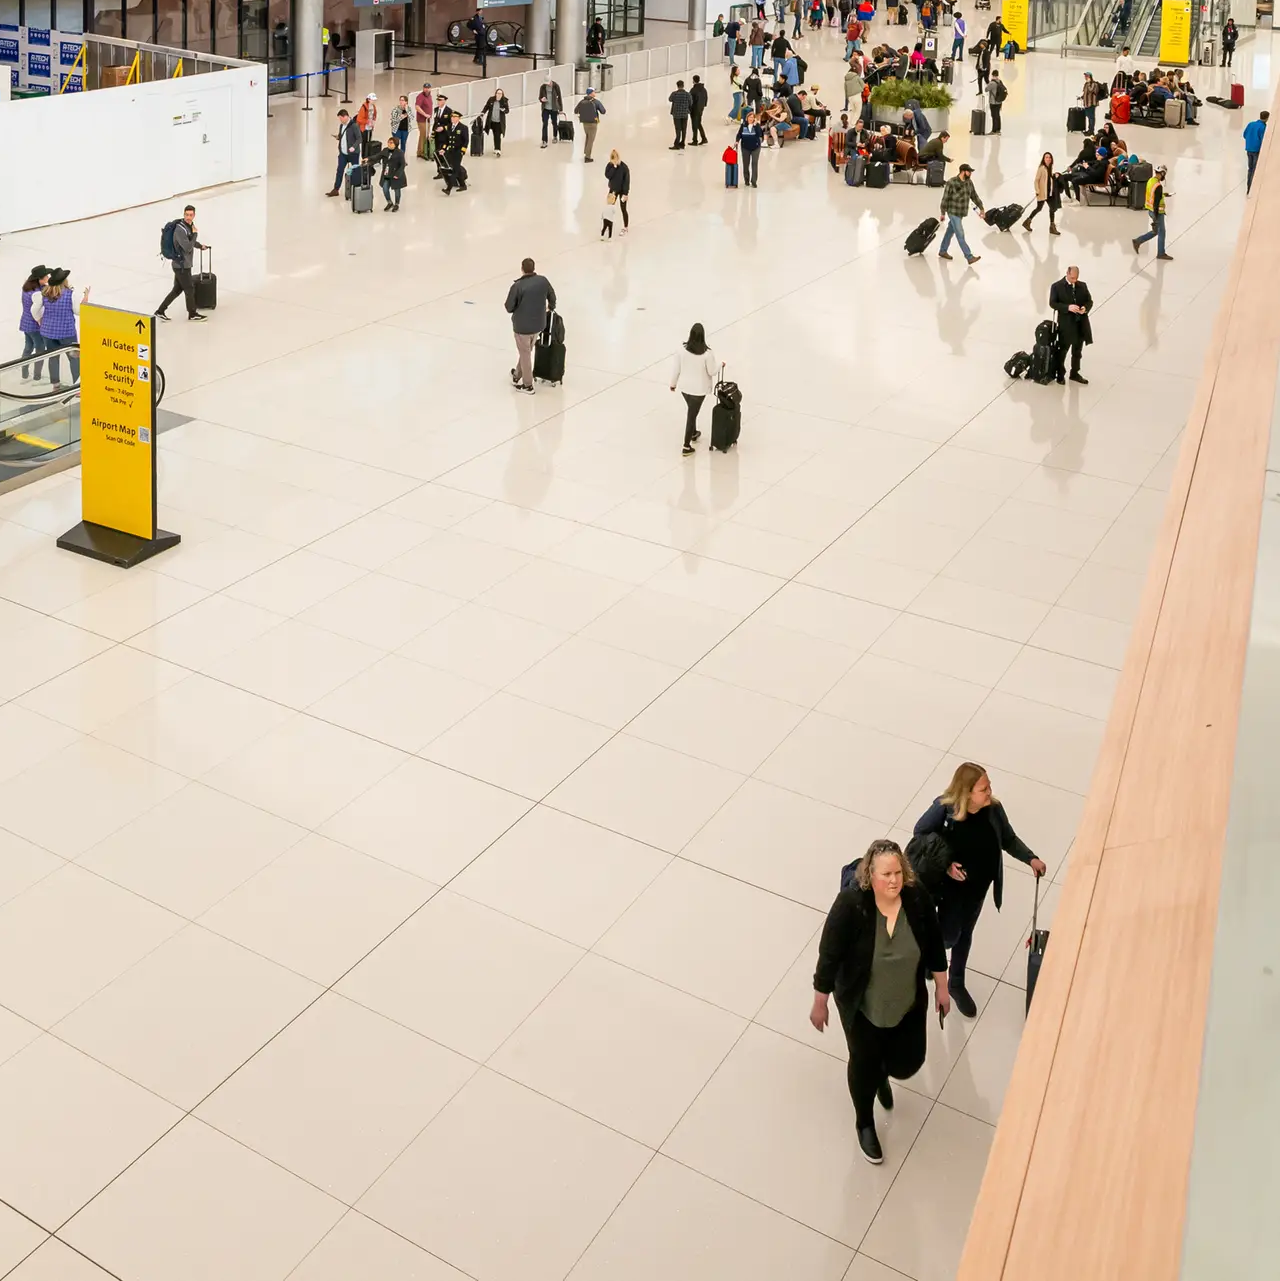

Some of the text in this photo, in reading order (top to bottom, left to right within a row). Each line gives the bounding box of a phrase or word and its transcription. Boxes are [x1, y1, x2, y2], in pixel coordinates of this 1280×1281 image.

[102, 338, 135, 352] All Gates
[113, 362, 134, 374] North
[104, 371, 135, 387] Security
[110, 396, 119, 404] TSA
[92, 417, 136, 438] Airport Map
[106, 434, 116, 442] Scan
[124, 439, 136, 447] Code
